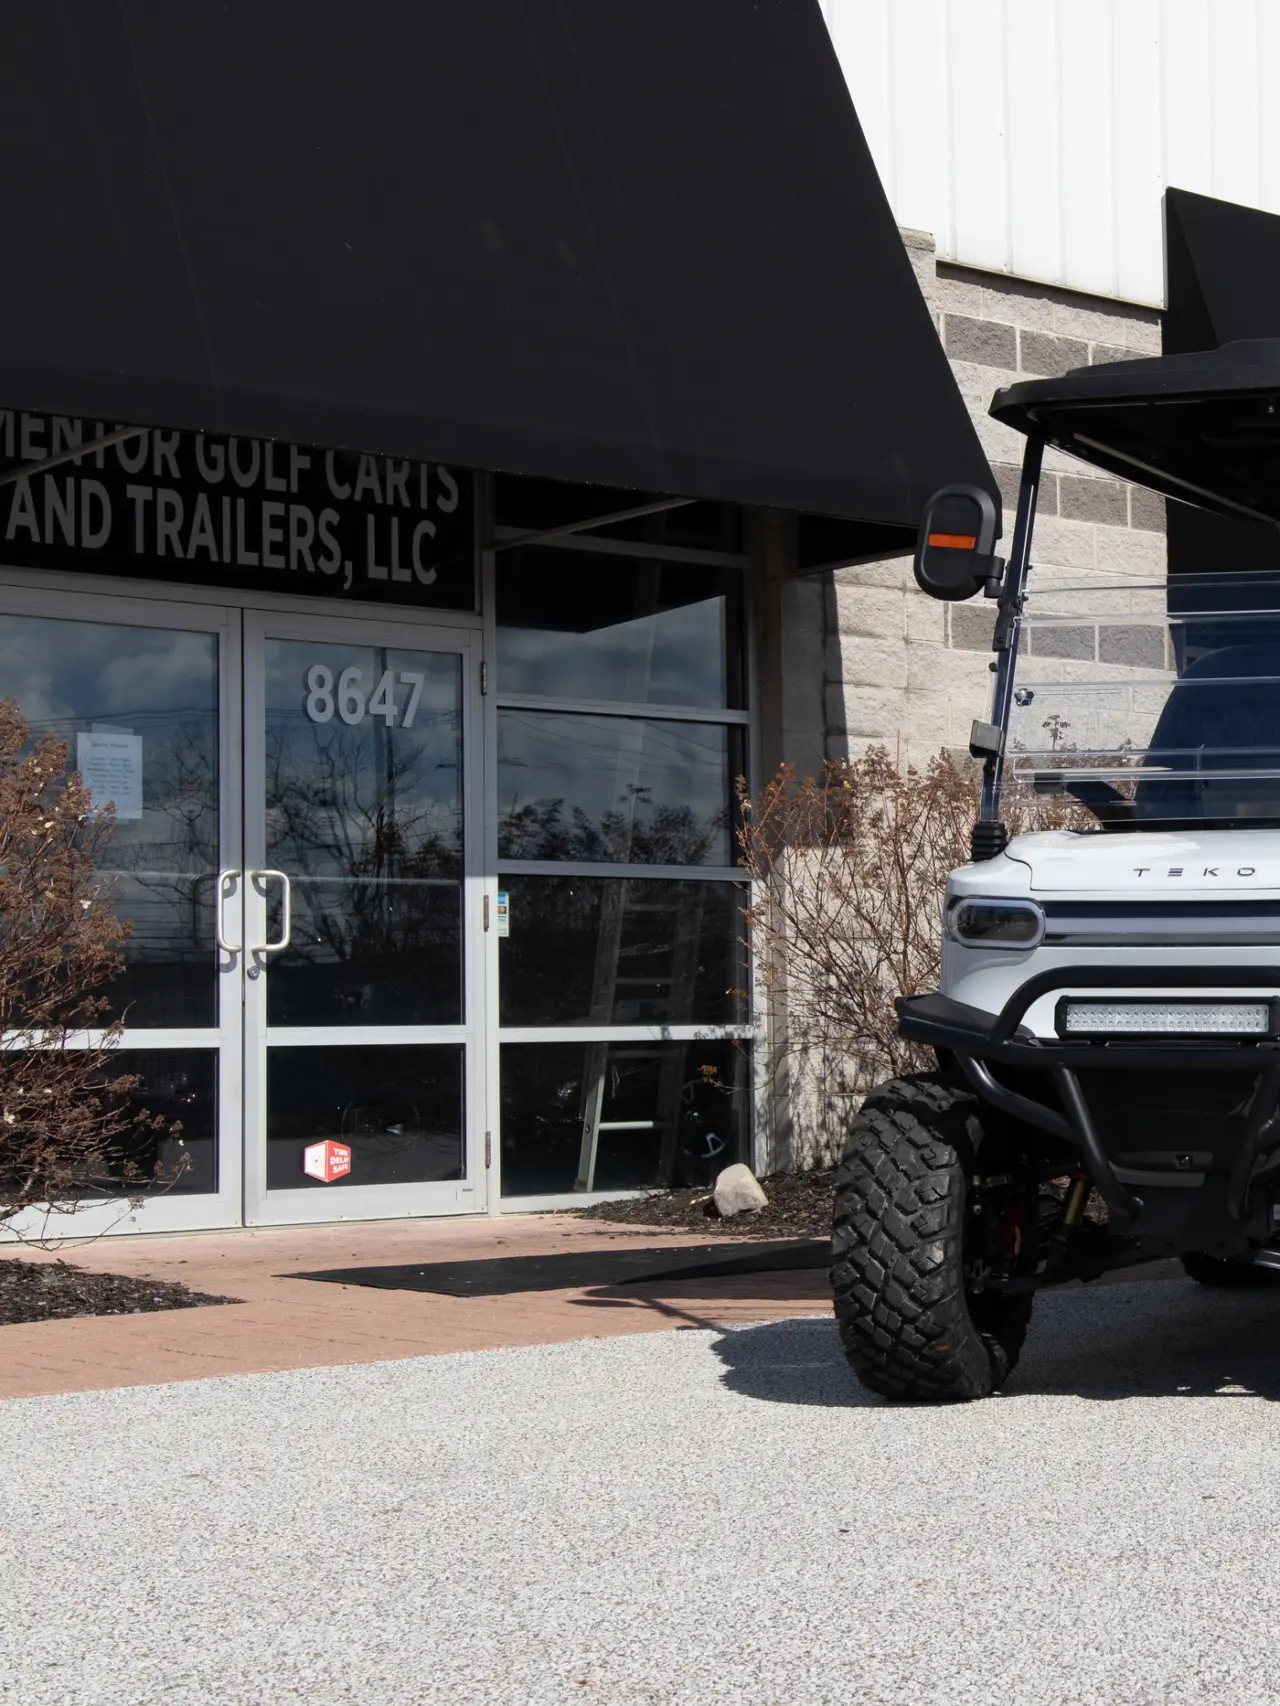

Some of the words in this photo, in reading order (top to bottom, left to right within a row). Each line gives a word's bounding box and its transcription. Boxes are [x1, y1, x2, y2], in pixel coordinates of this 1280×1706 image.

[195, 433, 311, 494] GOLF
[6, 472, 112, 549] AND
[126, 484, 353, 590] TRAILERS,
[366, 513, 438, 585] LLC
[306, 664, 425, 728] 8647
[1132, 867, 1256, 878] TEKO
